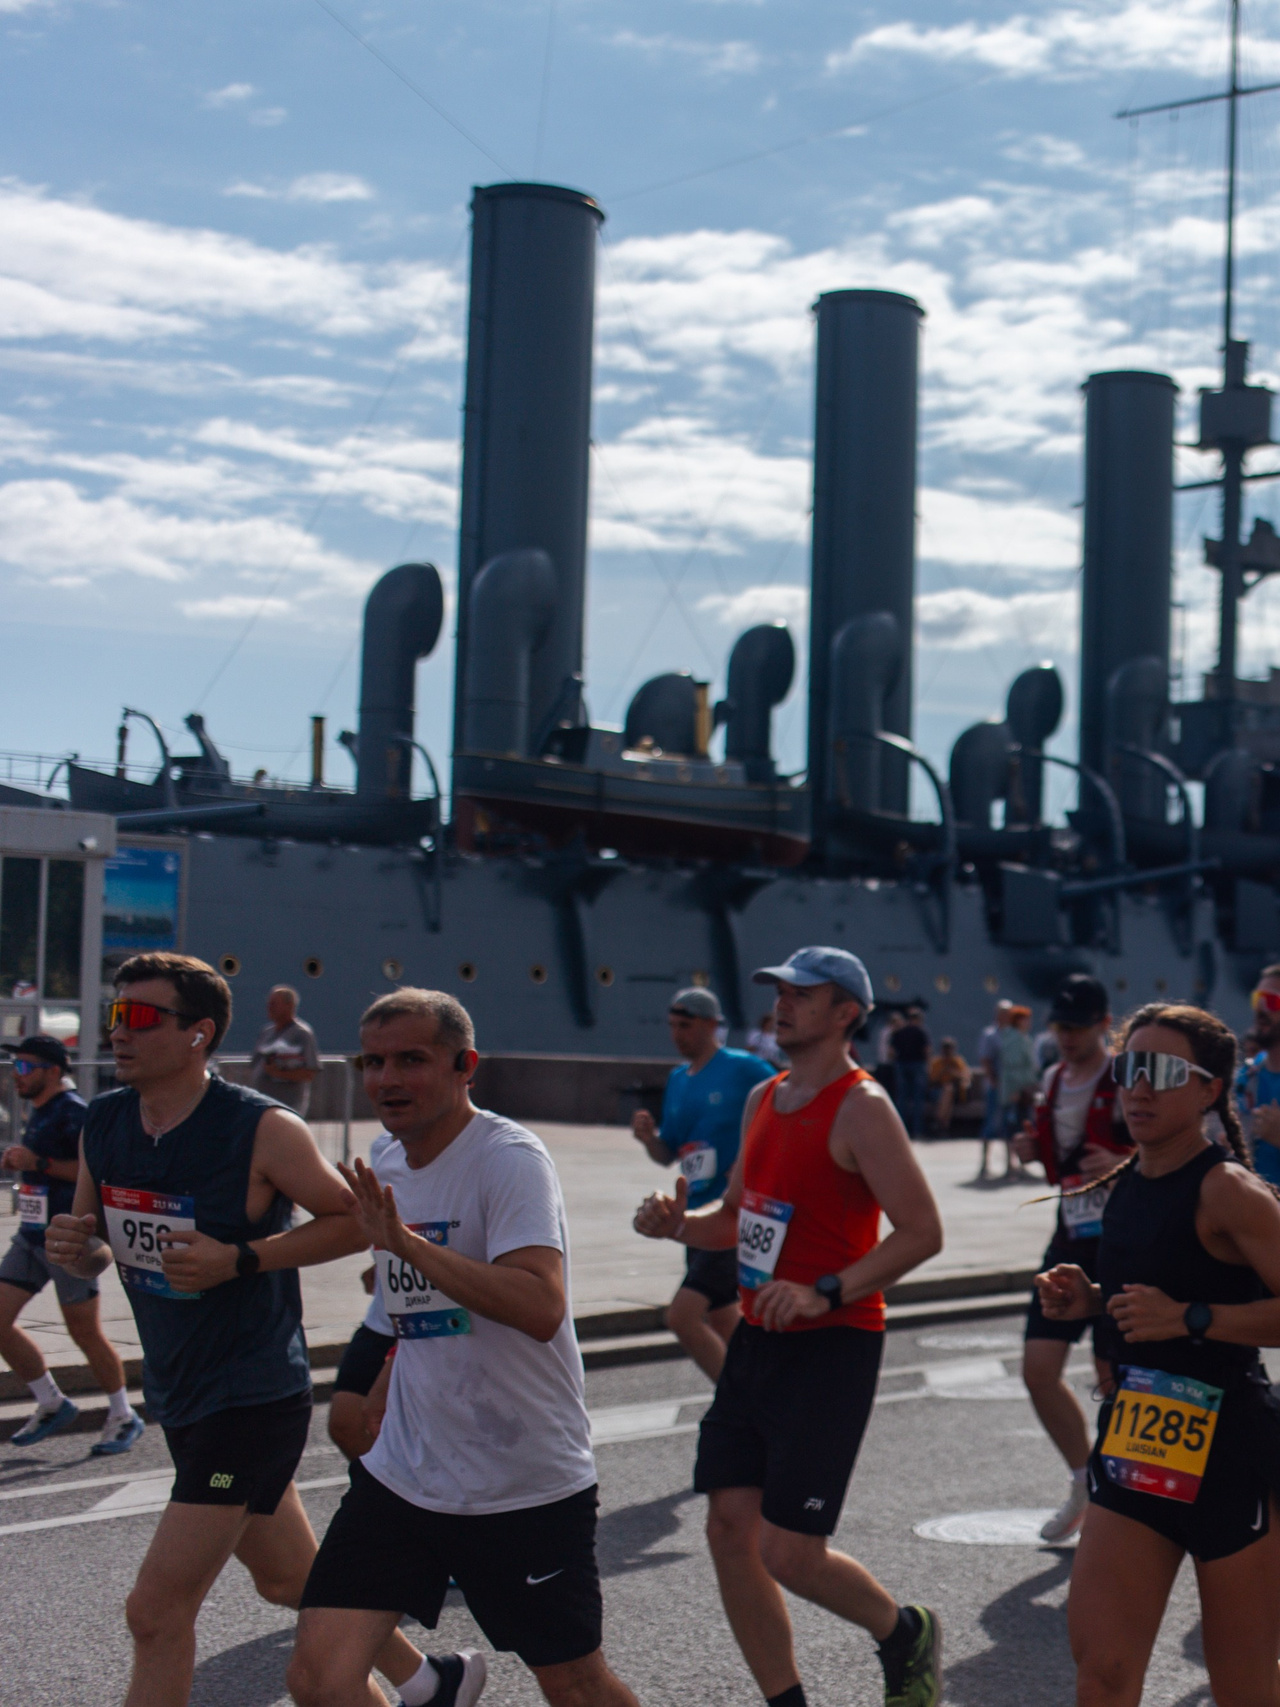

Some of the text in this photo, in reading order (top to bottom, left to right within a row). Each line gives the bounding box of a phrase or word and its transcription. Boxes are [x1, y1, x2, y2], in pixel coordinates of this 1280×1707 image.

[135, 1253, 162, 1267] ИГОРЬ
[405, 1295, 431, 1308] ДИНАР
[1114, 1400, 1209, 1452] 11285
